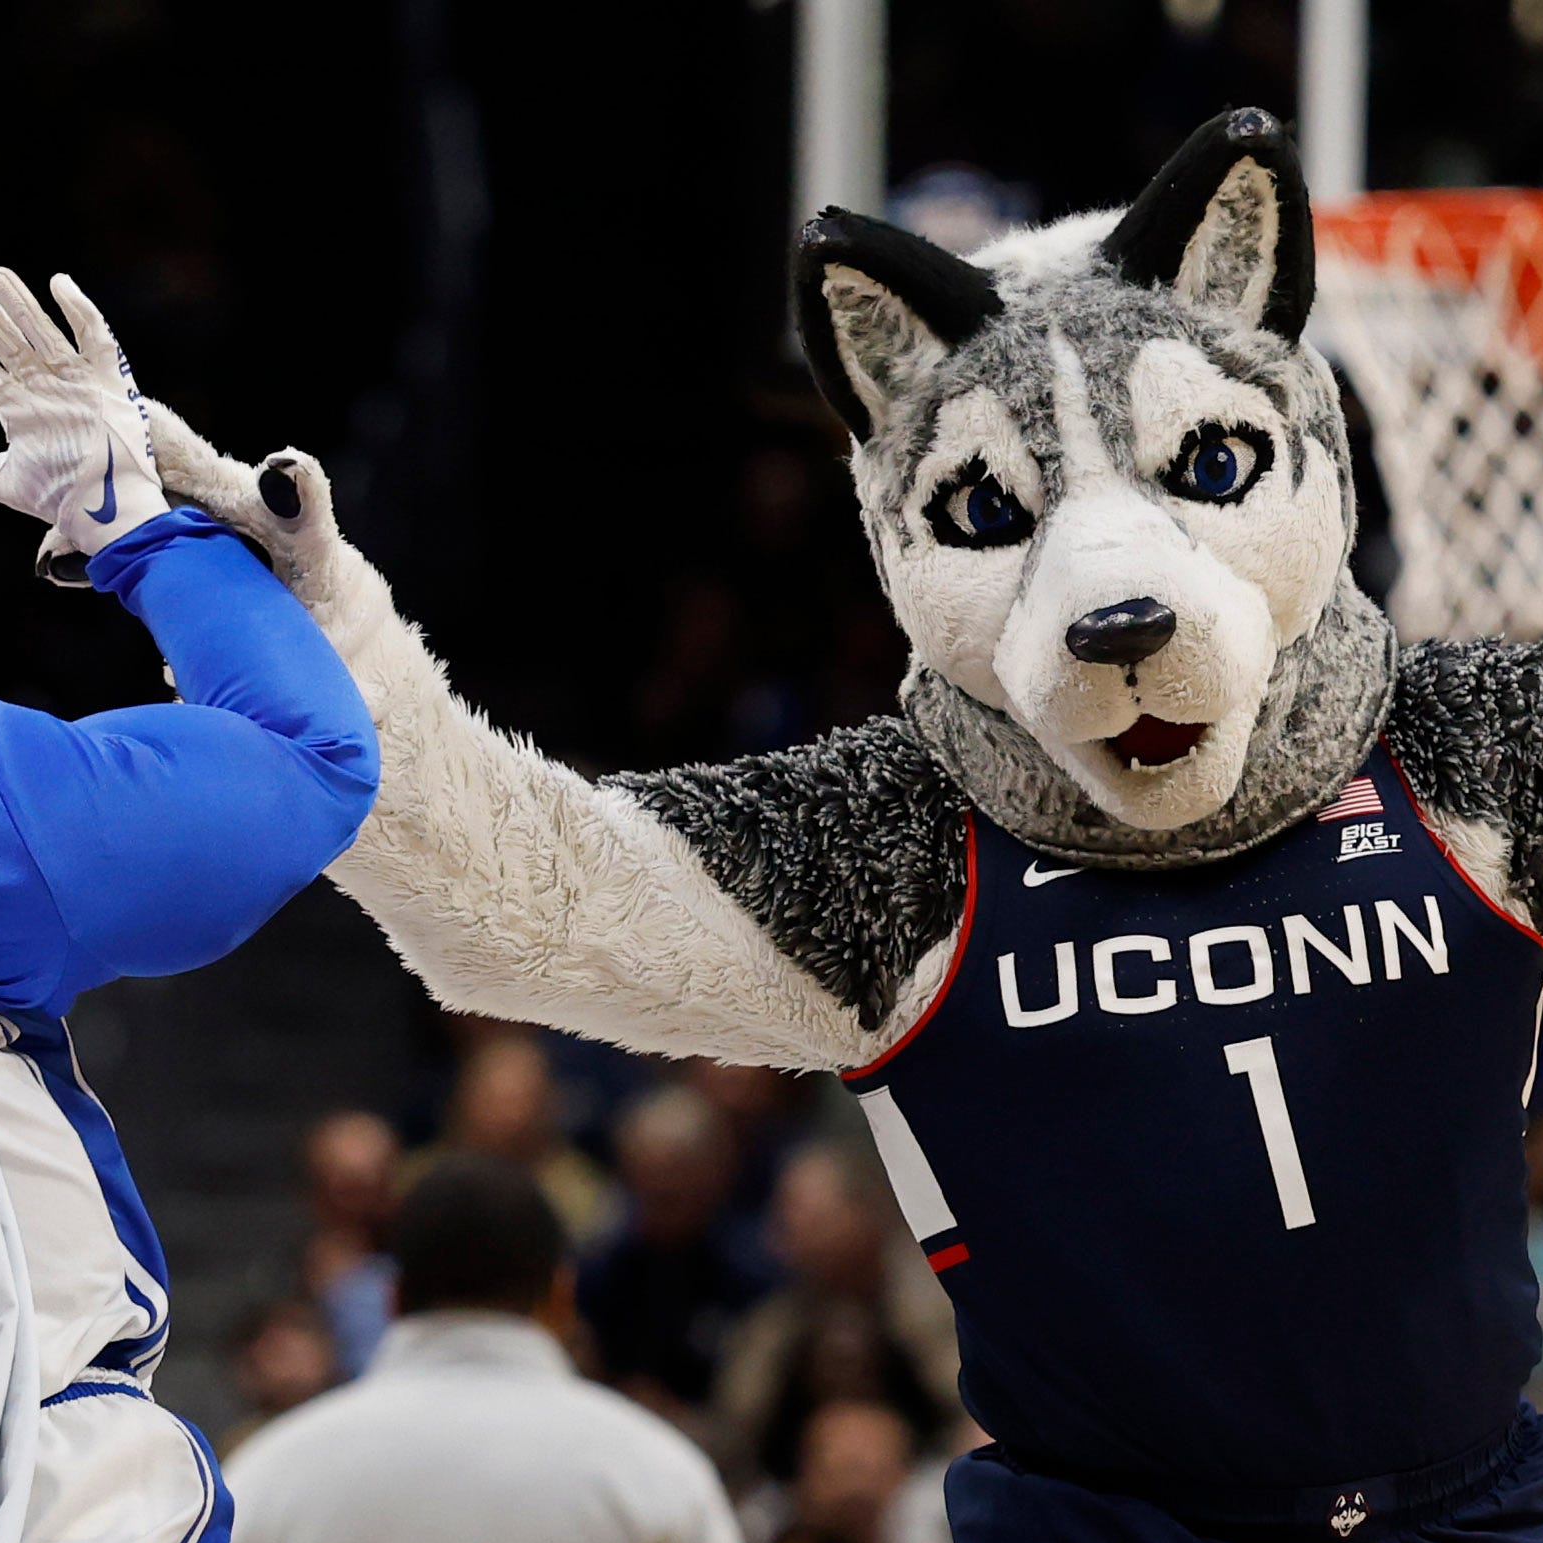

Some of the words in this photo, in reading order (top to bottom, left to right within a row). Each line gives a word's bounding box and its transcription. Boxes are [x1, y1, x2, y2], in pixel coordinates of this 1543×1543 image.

[1341, 822, 1385, 841] BIG
[1341, 834, 1401, 854] EAST
[997, 895, 1449, 1028] UCONN
[1223, 1036, 1317, 1230] 1
